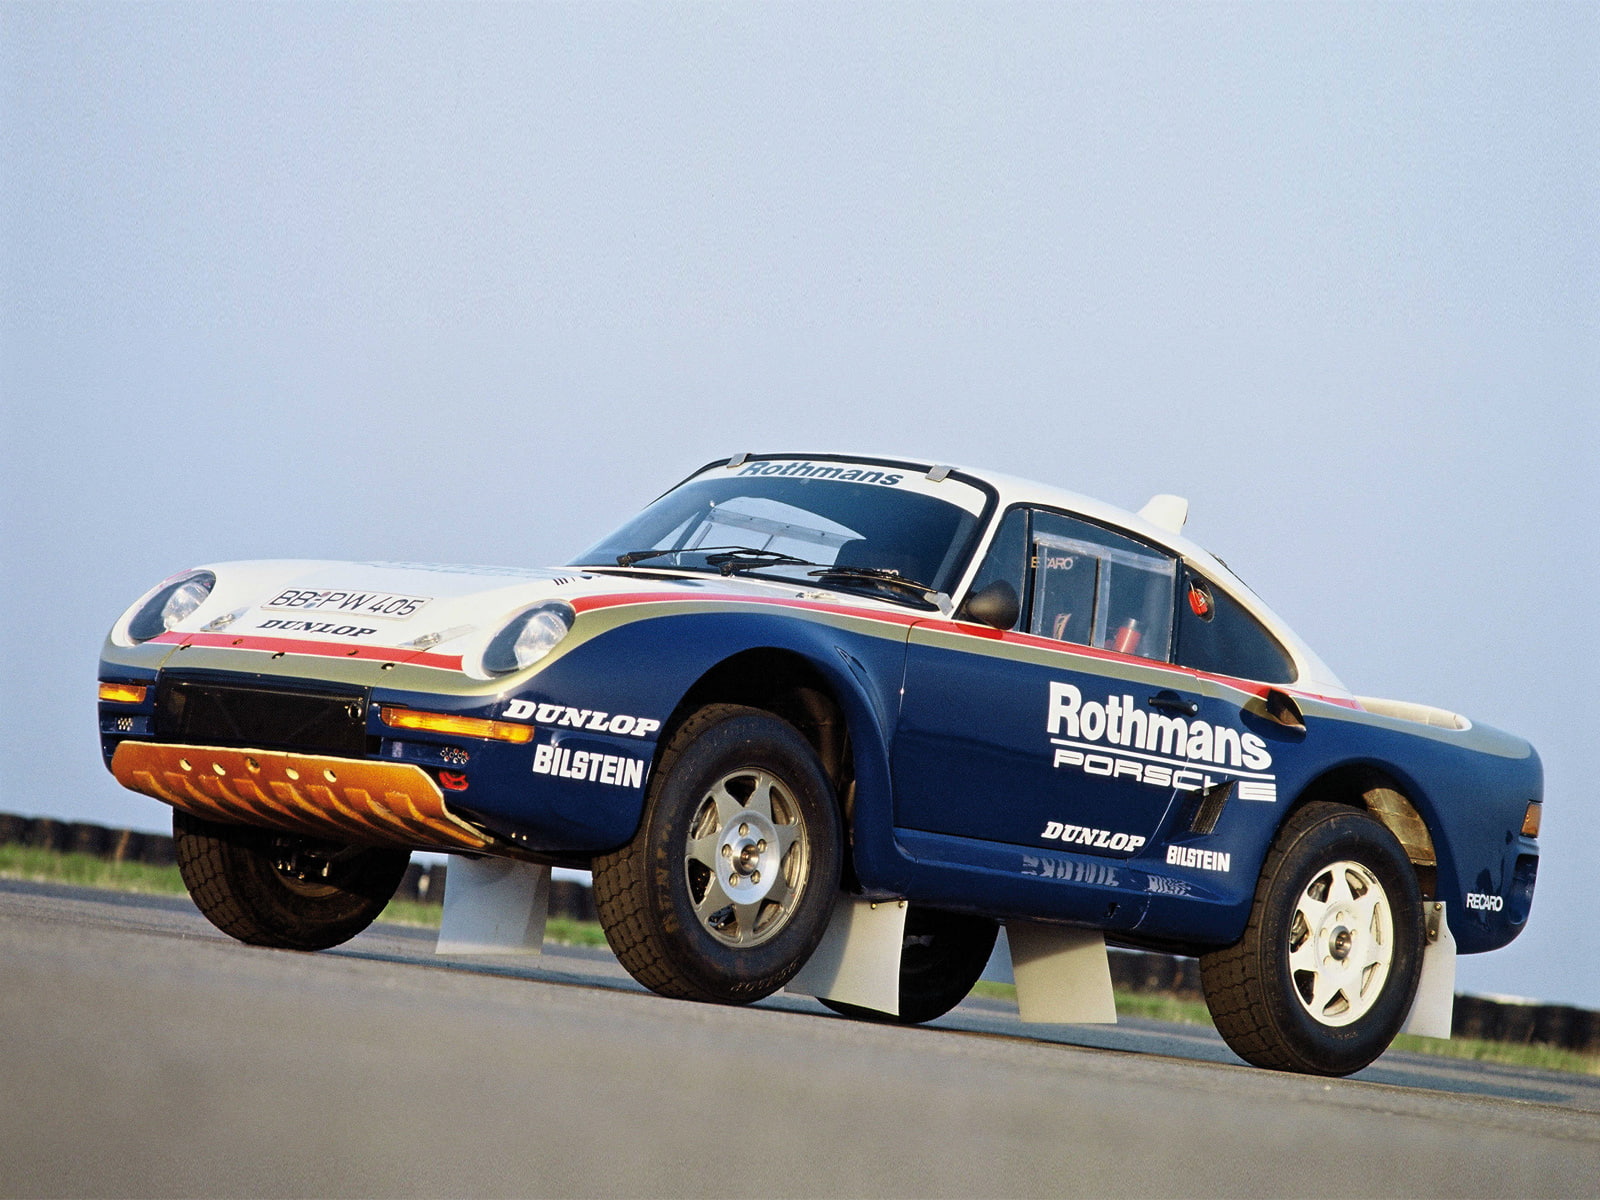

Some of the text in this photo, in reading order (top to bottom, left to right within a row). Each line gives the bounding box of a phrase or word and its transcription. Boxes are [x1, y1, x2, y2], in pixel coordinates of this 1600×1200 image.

[738, 461, 903, 486] Rothmans
[368, 596, 424, 616] 405
[256, 619, 377, 637] DUNLOP
[502, 698, 661, 737] DUNLOP
[1047, 681, 1272, 770] Rothmans
[532, 744, 644, 789] BILSTEIN
[1041, 821, 1146, 852] DUNLOP
[1166, 845, 1231, 872] BILSTEIN
[1466, 893, 1503, 912] RECARO
